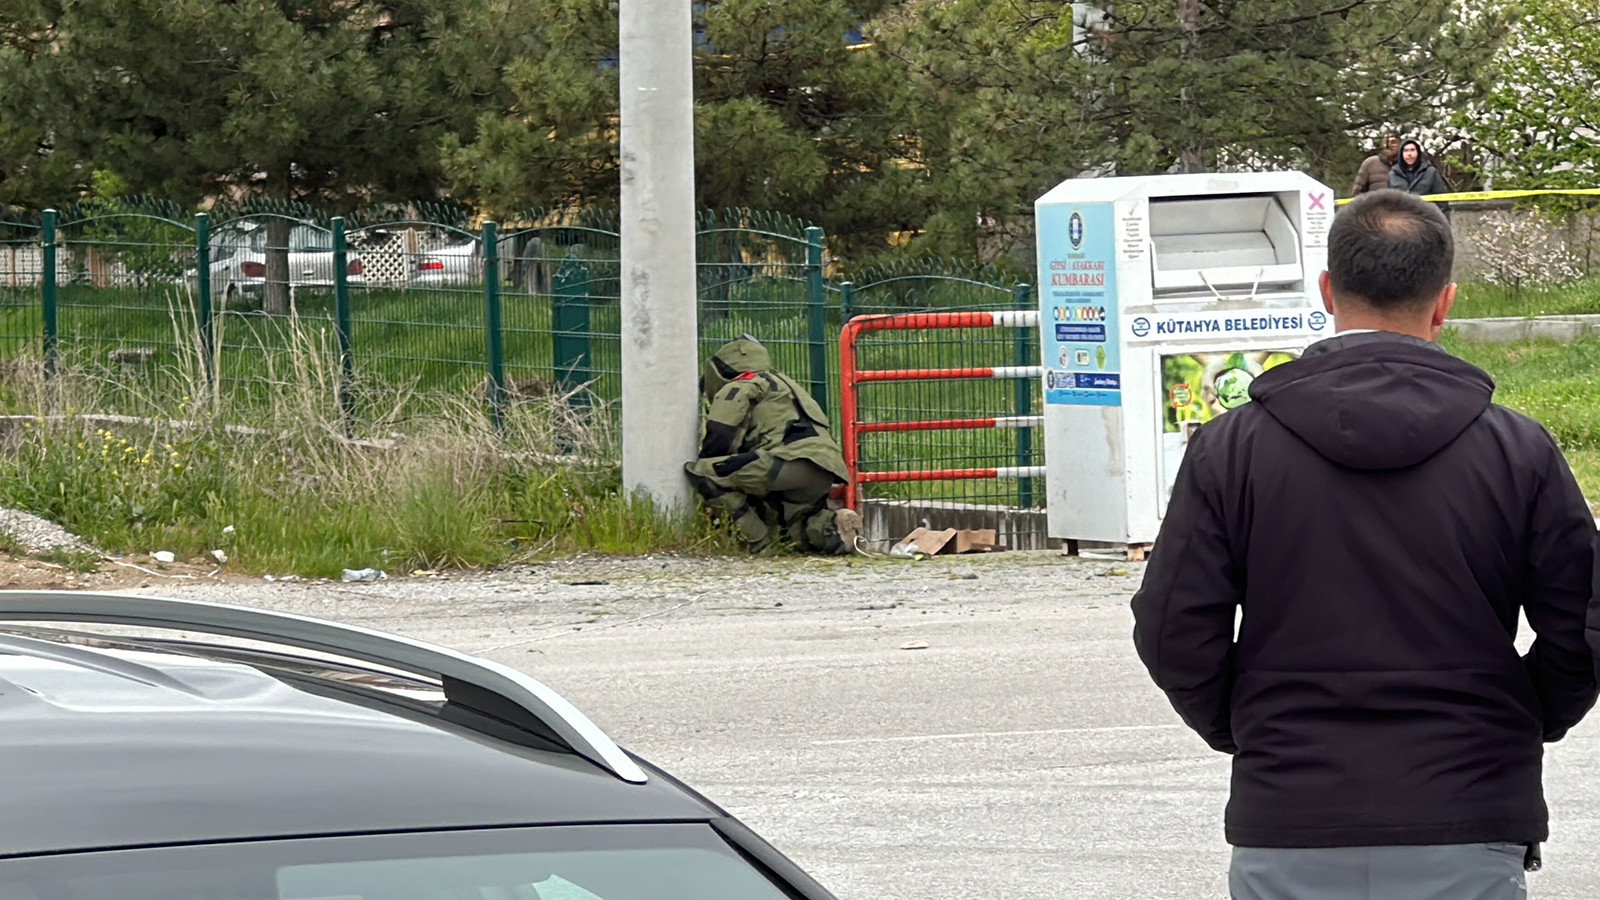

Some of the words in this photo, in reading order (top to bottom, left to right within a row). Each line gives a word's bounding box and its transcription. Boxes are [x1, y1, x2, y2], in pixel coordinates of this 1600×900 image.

[1051, 273, 1104, 286] KUMBARASI
[1156, 318, 1221, 334] KÜTAHYA
[1224, 314, 1303, 332] BELEDİYESİ
